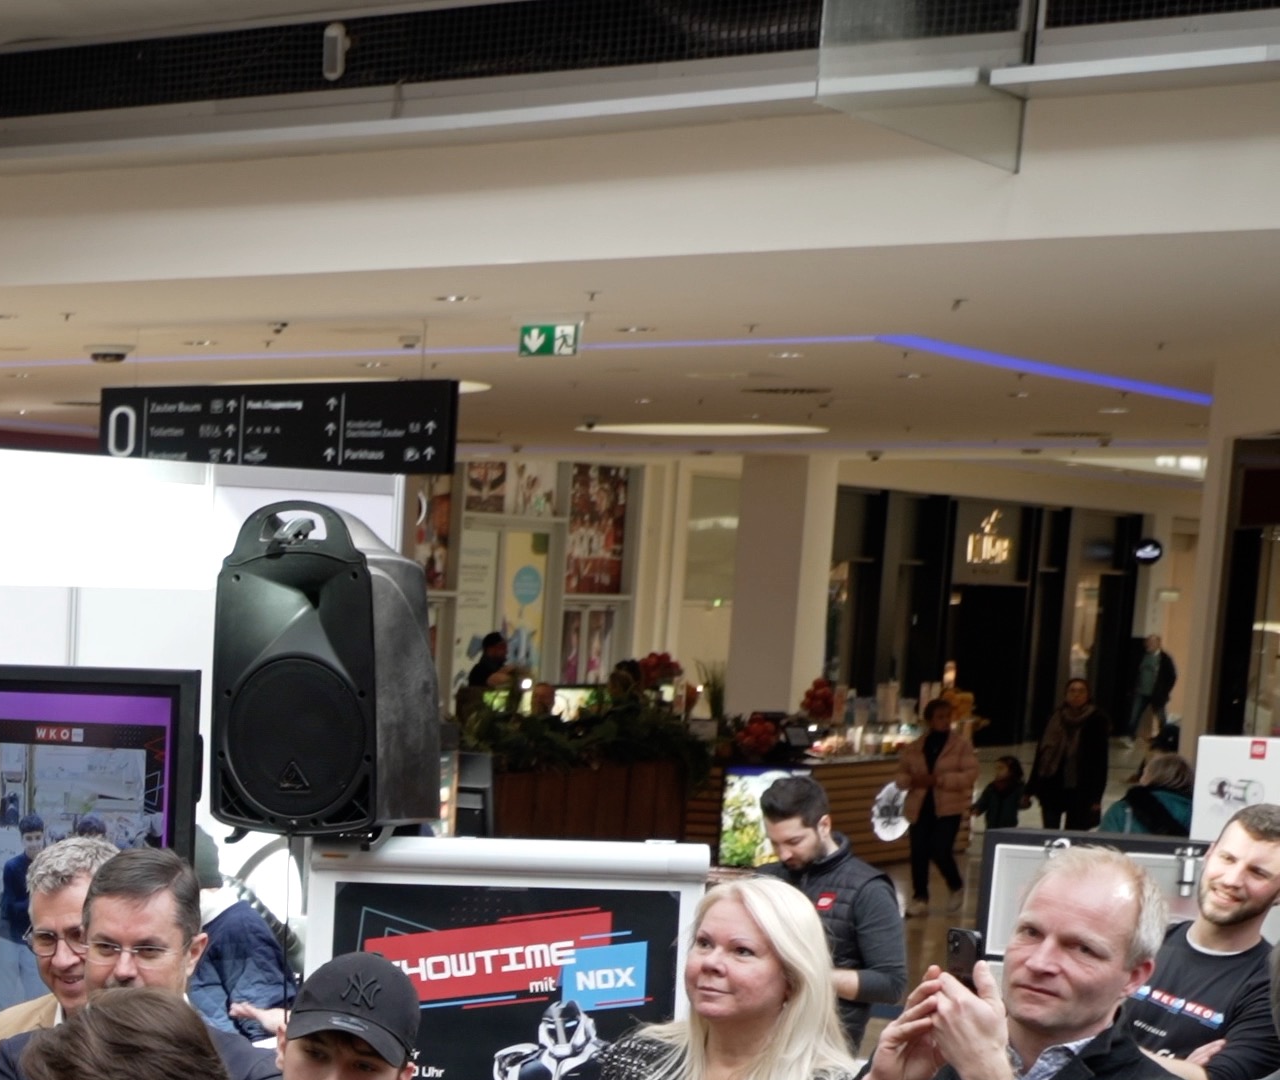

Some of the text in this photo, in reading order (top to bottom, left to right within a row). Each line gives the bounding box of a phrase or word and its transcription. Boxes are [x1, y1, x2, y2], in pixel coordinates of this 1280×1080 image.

[36, 727, 70, 740] WKO
[392, 940, 577, 982] HOWTIME
[528, 966, 636, 993] mit NOX
[421, 1066, 446, 1078] Uhr
